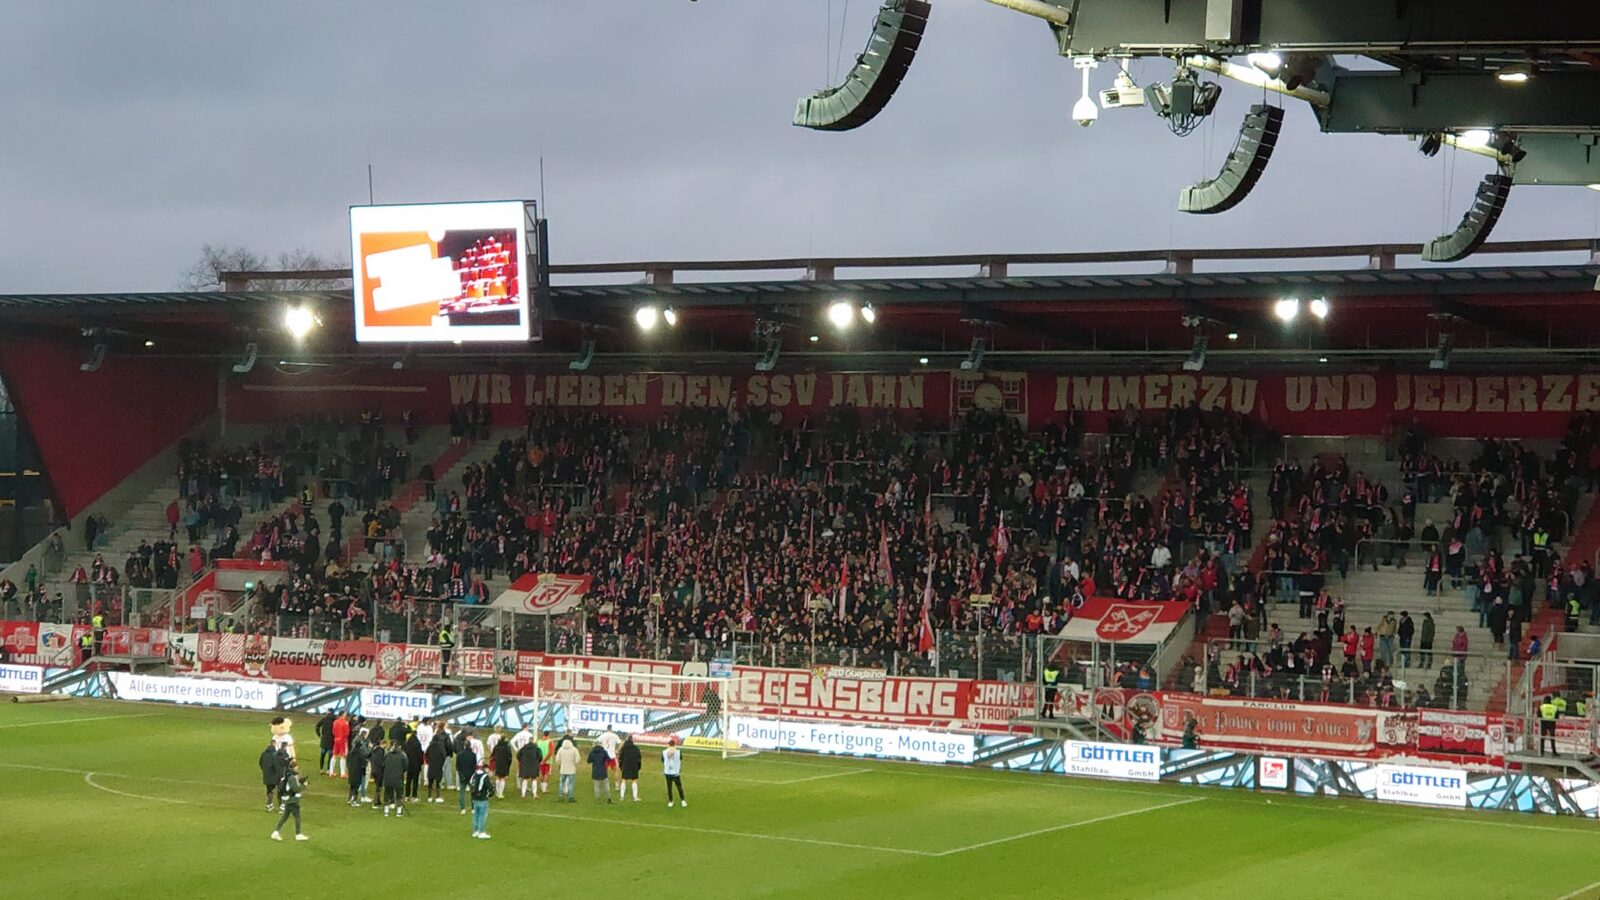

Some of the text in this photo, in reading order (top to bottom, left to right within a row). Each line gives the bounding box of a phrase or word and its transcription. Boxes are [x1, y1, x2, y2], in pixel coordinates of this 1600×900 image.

[449, 375, 512, 404] WIR
[661, 375, 733, 407] DEN
[747, 375, 817, 406] SSV
[830, 374, 924, 408] JAHN
[1055, 375, 1258, 413] IMMERZU
[1285, 375, 1378, 410] UND
[270, 651, 355, 669] REGENSBURG
[357, 654, 375, 669] 81
[0, 667, 38, 680] ÖTTLER
[129, 679, 263, 700] Alles unter einem Dach
[554, 659, 958, 716] ULTRAS REGENSBURG
[975, 683, 1020, 705] JAHN
[373, 693, 427, 708] GÖTTLER
[1242, 702, 1296, 710] FANCLUB
[580, 709, 639, 725] GÖTTLER
[1216, 711, 1261, 732] Power
[1302, 717, 1349, 735] Tower
[737, 725, 795, 748] Planung
[811, 729, 883, 753] Fertigung
[899, 735, 966, 757] Montage
[1081, 745, 1154, 764] GÖTTLER
[1072, 765, 1154, 777] Stahlbau GmbH
[1392, 772, 1460, 788] GÖTTLER
